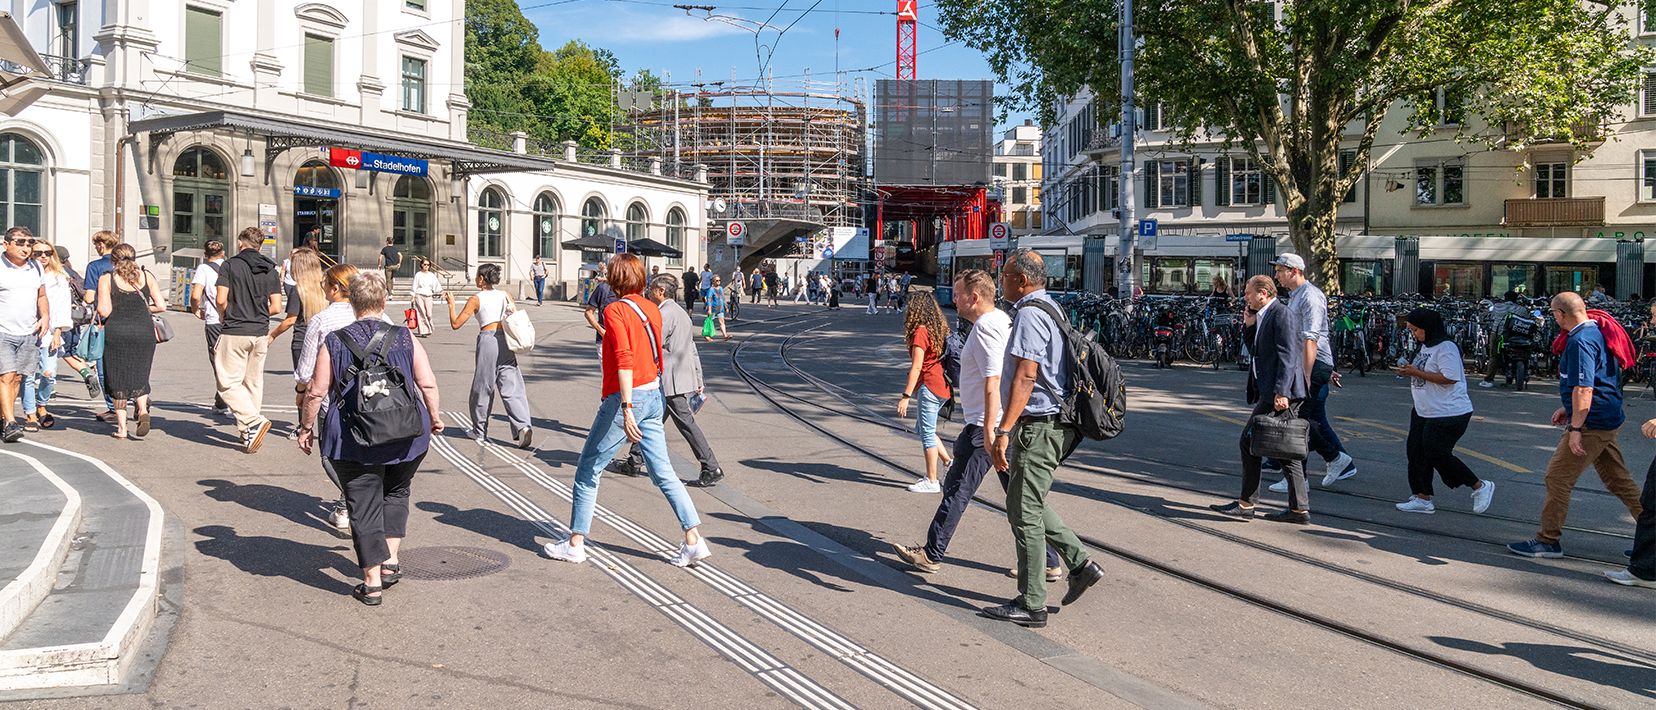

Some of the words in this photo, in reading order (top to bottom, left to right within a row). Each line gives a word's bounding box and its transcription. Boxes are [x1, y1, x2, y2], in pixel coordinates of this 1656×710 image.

[373, 159, 421, 174] Stadelhofen
[1144, 222, 1153, 234] P
[1514, 319, 1531, 329] Uber
